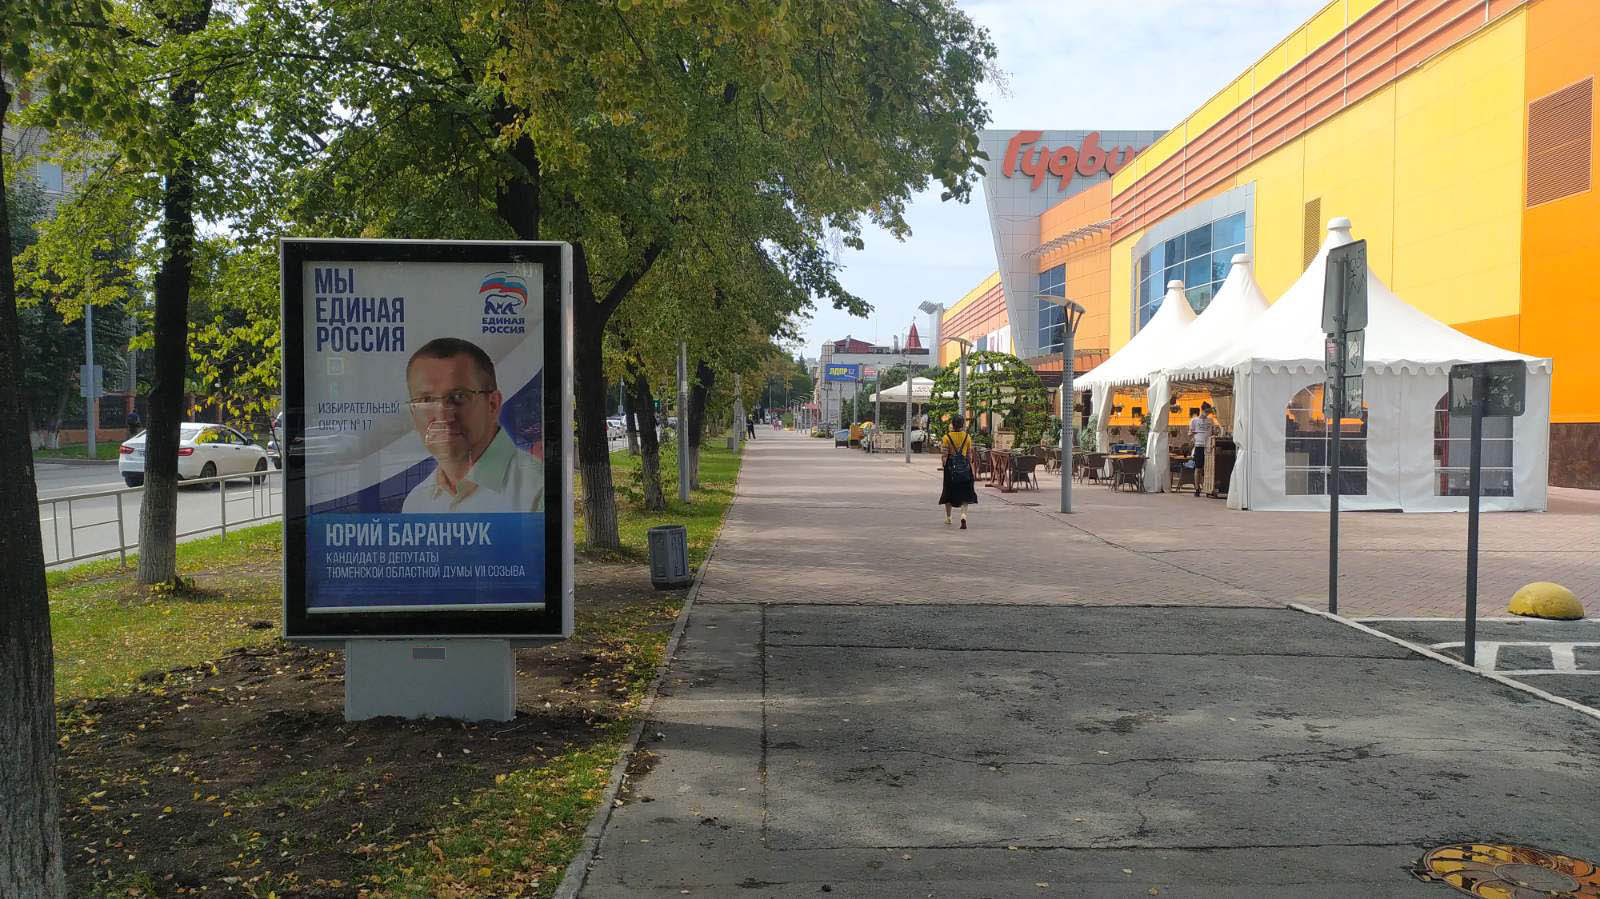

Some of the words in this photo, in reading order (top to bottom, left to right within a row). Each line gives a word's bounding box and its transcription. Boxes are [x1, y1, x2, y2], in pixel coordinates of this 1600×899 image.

[1002, 130, 1152, 192] Гудви
[314, 268, 354, 294] МЫ
[315, 297, 405, 326] ЕДИНАЯ
[482, 317, 525, 325] ЕДИНАЯ
[482, 325, 525, 334] РОССИЯ
[316, 326, 405, 352] РОССИЯ
[318, 400, 400, 414] ИЗБИРАТЕЛЬНЫЙ
[318, 419, 349, 431] ОКРУГ
[363, 419, 372, 430] 17
[326, 518, 383, 546] ЮРИЙ
[388, 522, 492, 546] БАРАНЧУК
[326, 551, 378, 565] КАНДИДАТ
[379, 552, 386, 563] В
[388, 551, 439, 564] ДЕПУТАТЫ
[326, 565, 384, 578] ТЮМЕНСКОЙ
[385, 565, 440, 578] ОБЛАСТНОЙ
[442, 565, 473, 578] ДУМЫ
[474, 565, 486, 577] VII
[487, 565, 525, 577] СОЗЫВА
